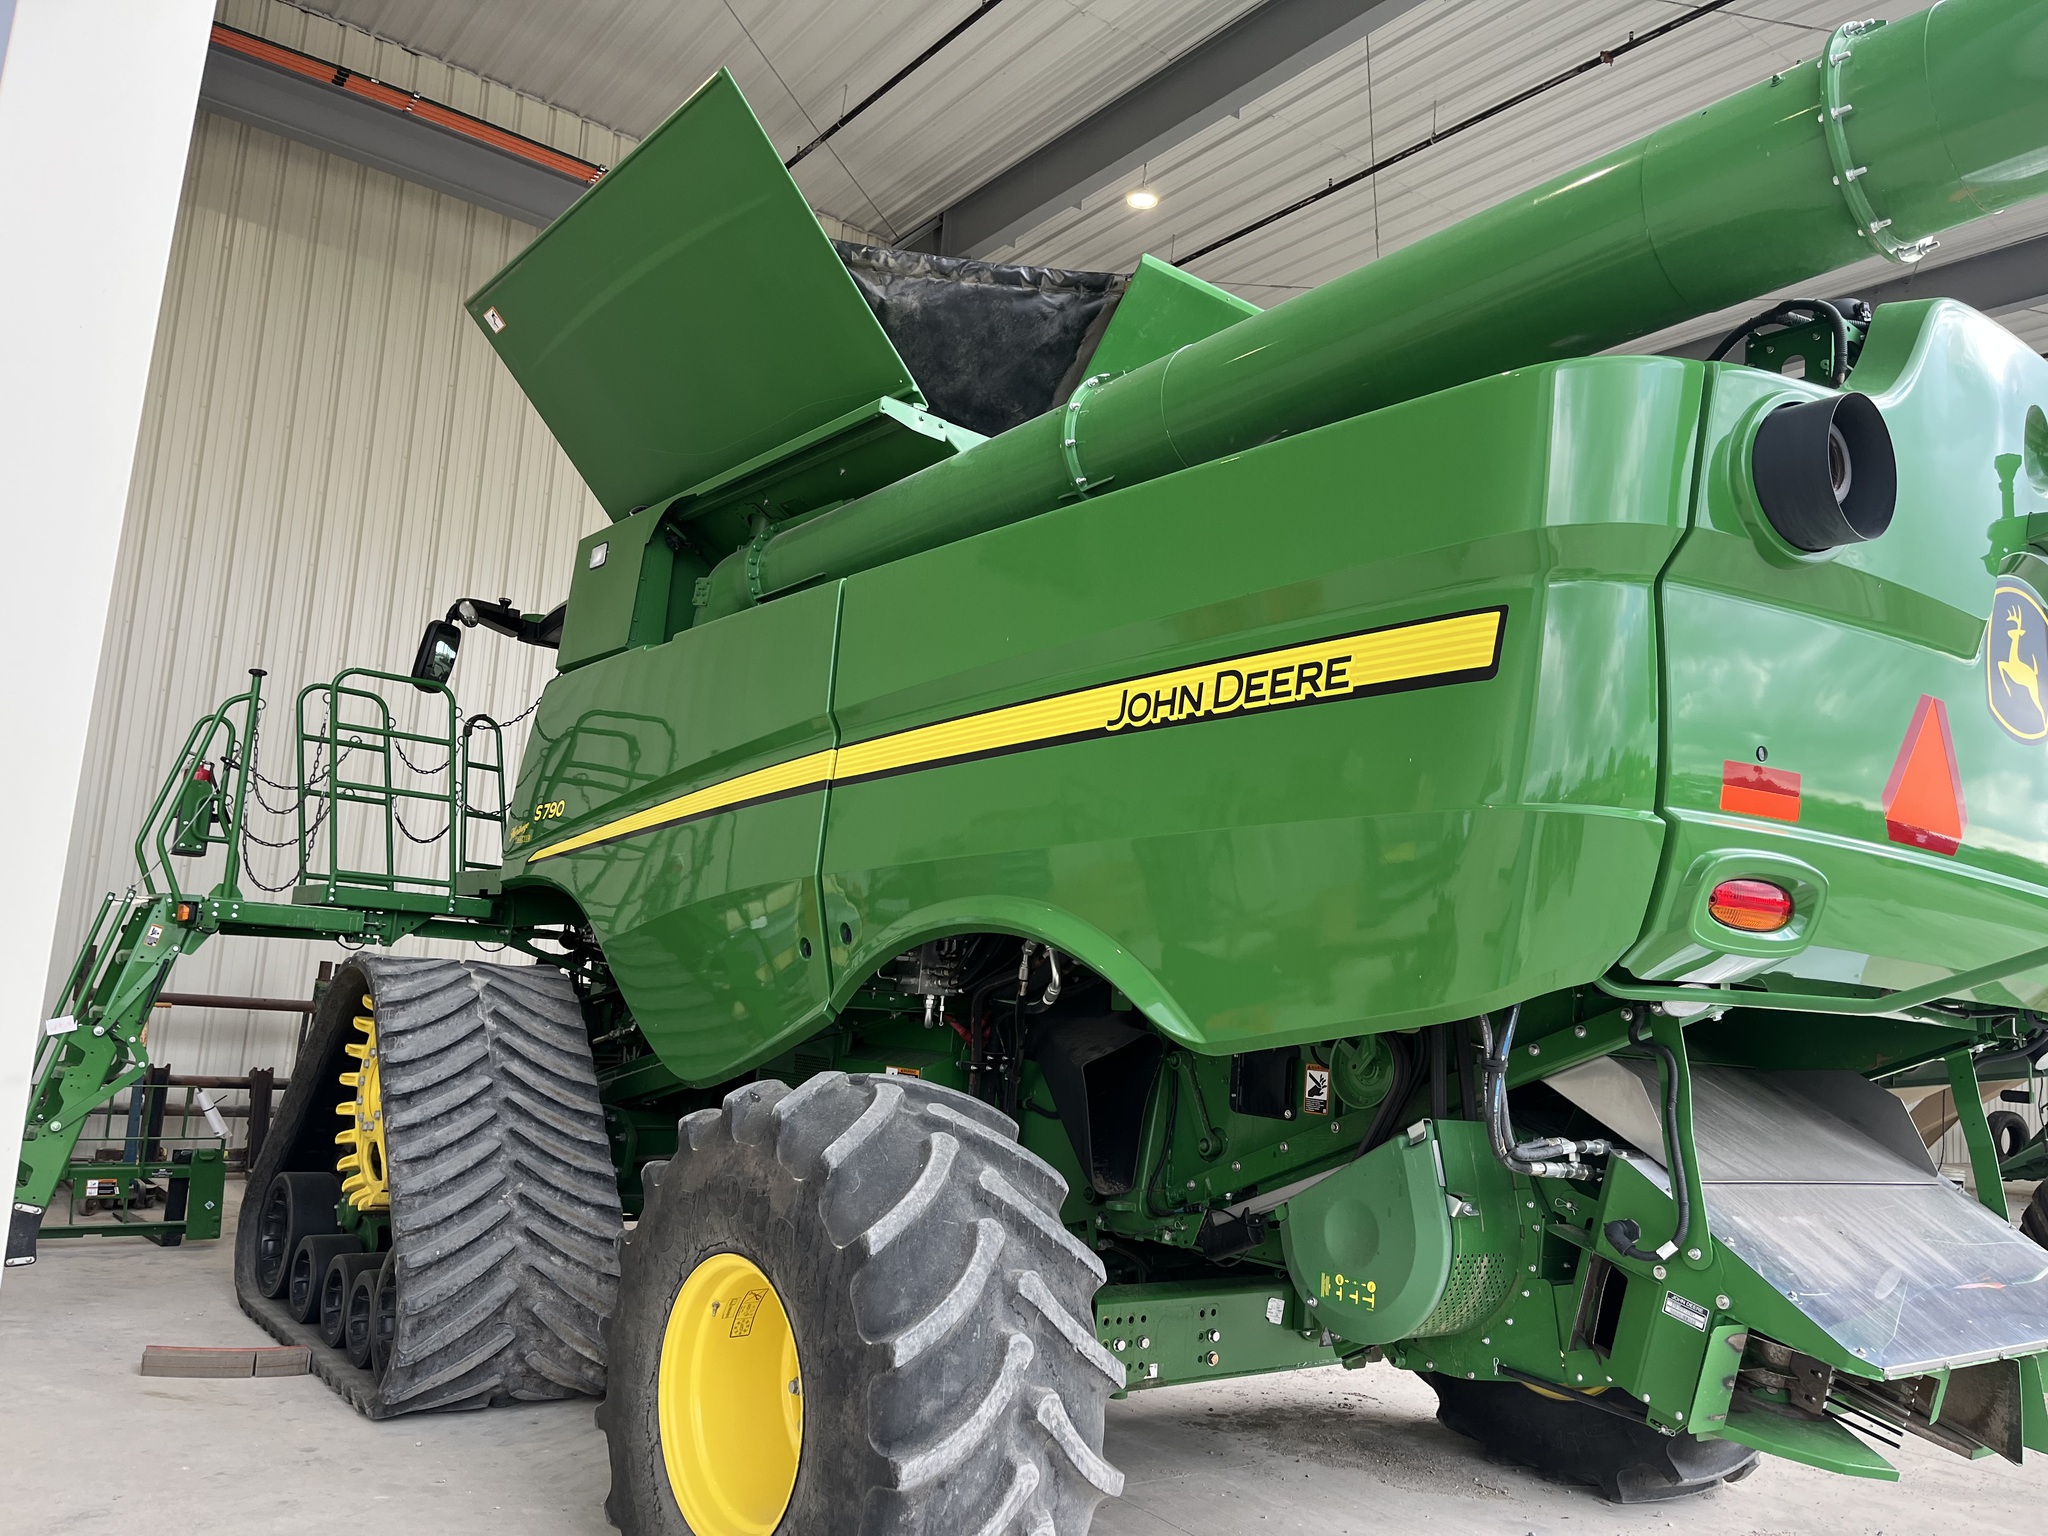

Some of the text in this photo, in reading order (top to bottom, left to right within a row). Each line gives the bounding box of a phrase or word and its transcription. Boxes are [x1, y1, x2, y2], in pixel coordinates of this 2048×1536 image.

[1106, 654, 1353, 728] JOHN DEERE
[533, 799, 566, 822] S790
